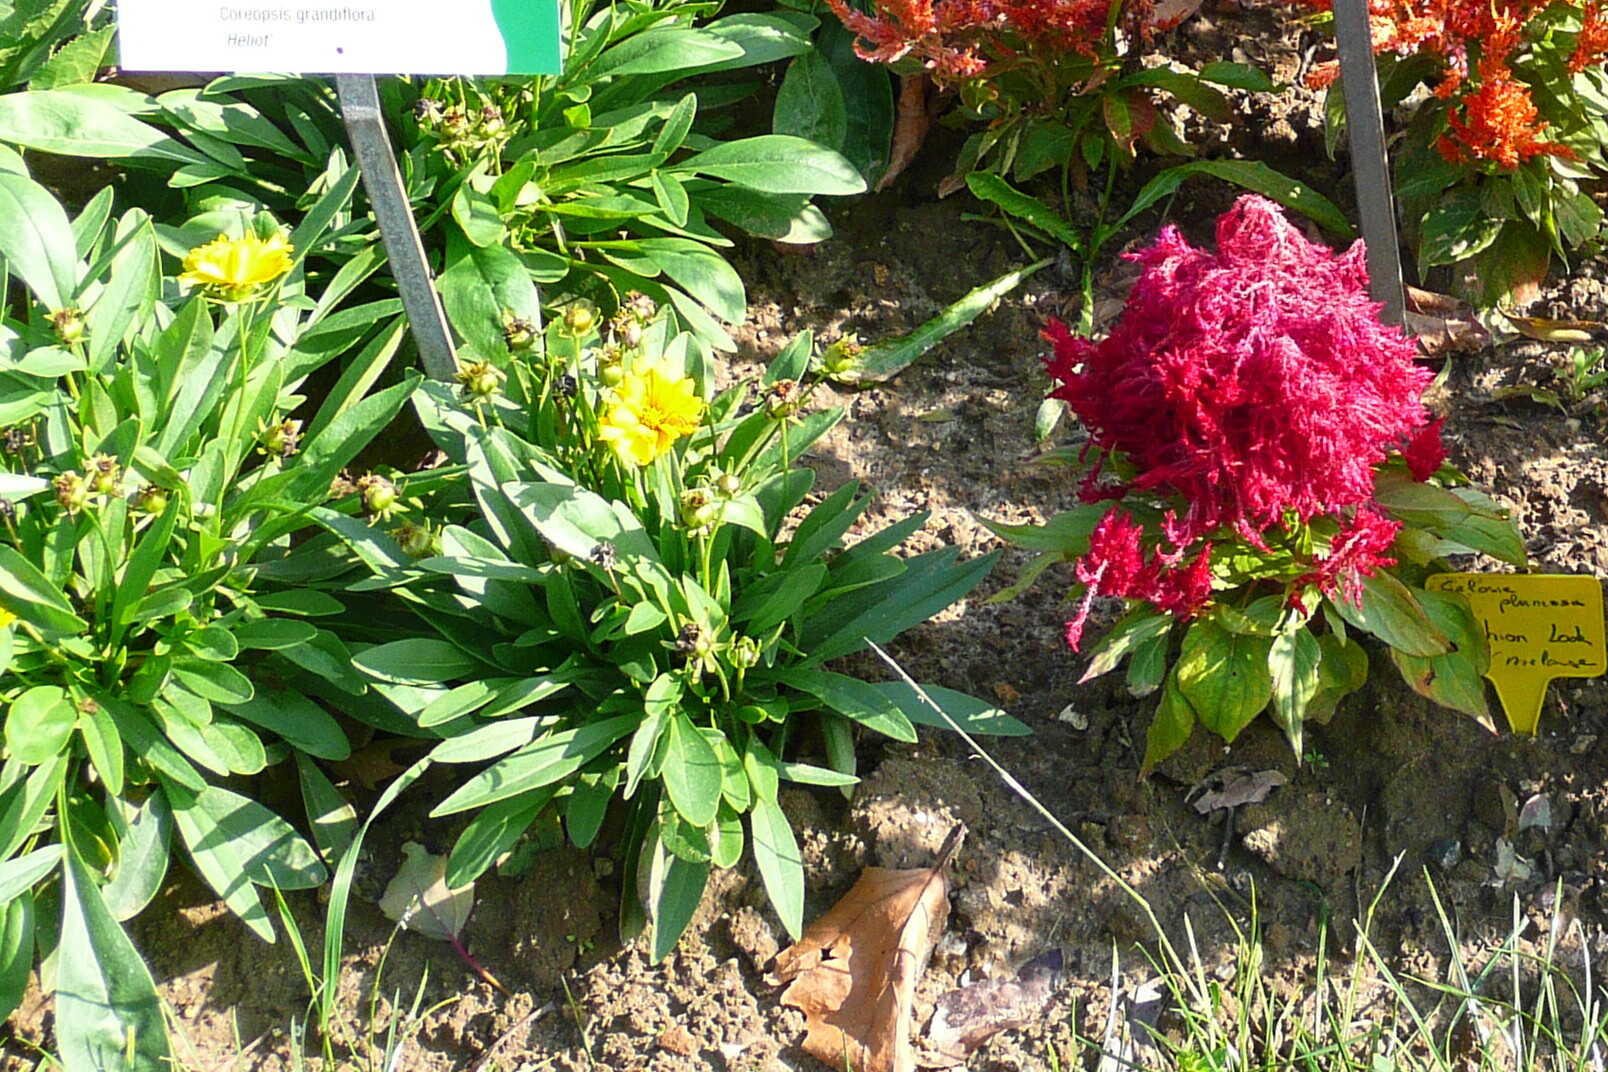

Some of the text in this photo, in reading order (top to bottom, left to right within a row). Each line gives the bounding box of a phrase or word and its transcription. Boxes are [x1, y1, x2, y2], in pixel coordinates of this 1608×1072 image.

[219, 6, 375, 25] Coreopsis grandiflora
[1484, 618, 1529, 643] hion
